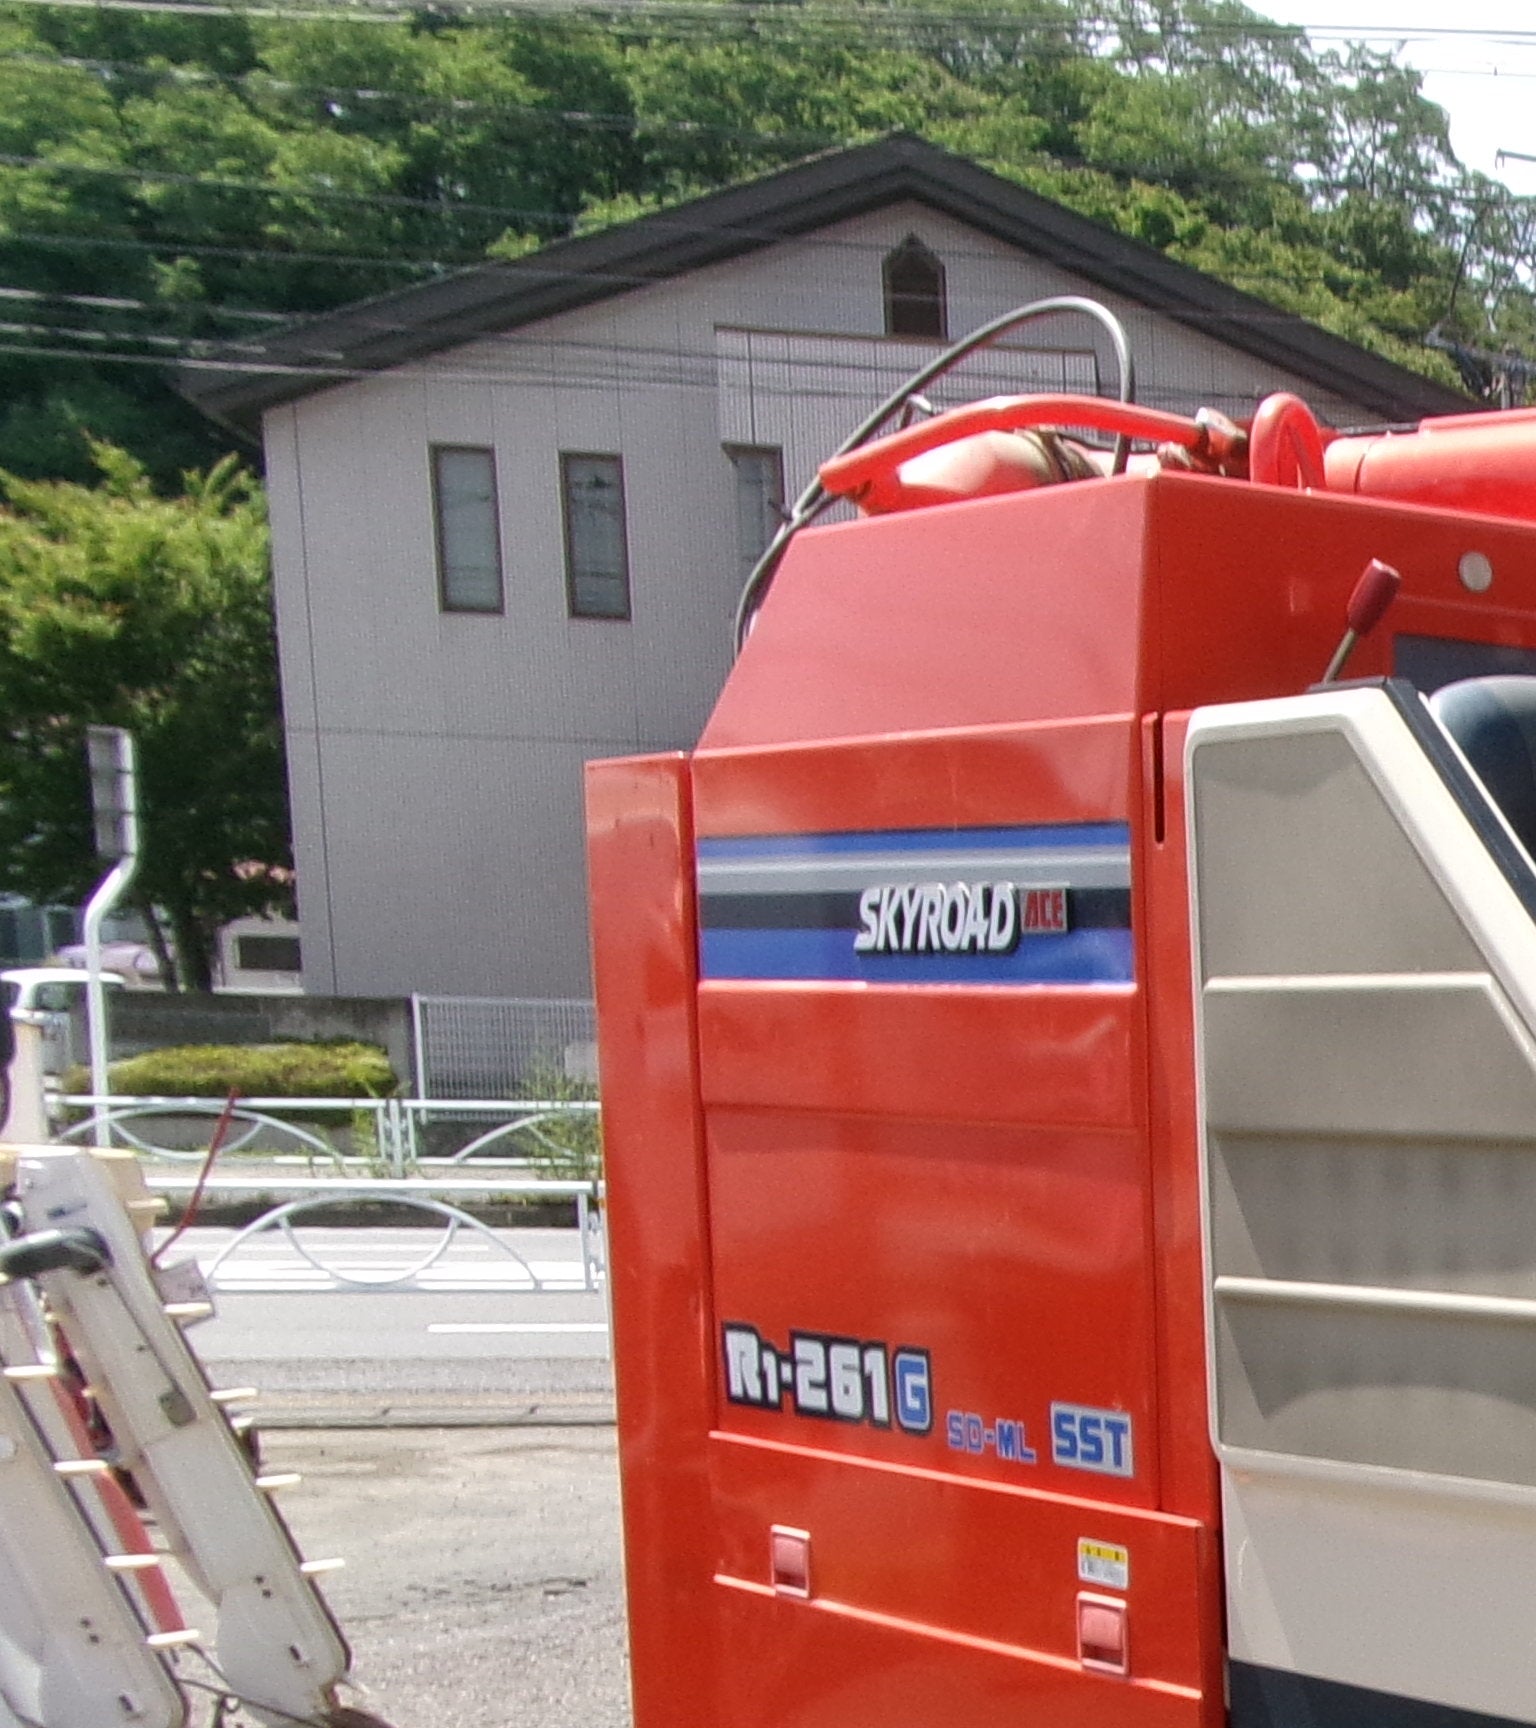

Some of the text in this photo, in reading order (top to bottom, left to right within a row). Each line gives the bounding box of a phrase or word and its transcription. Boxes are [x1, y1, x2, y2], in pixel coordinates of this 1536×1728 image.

[854, 881, 1063, 951] SKYROAD ACE
[946, 1410, 1129, 1469] SD-ML SST
